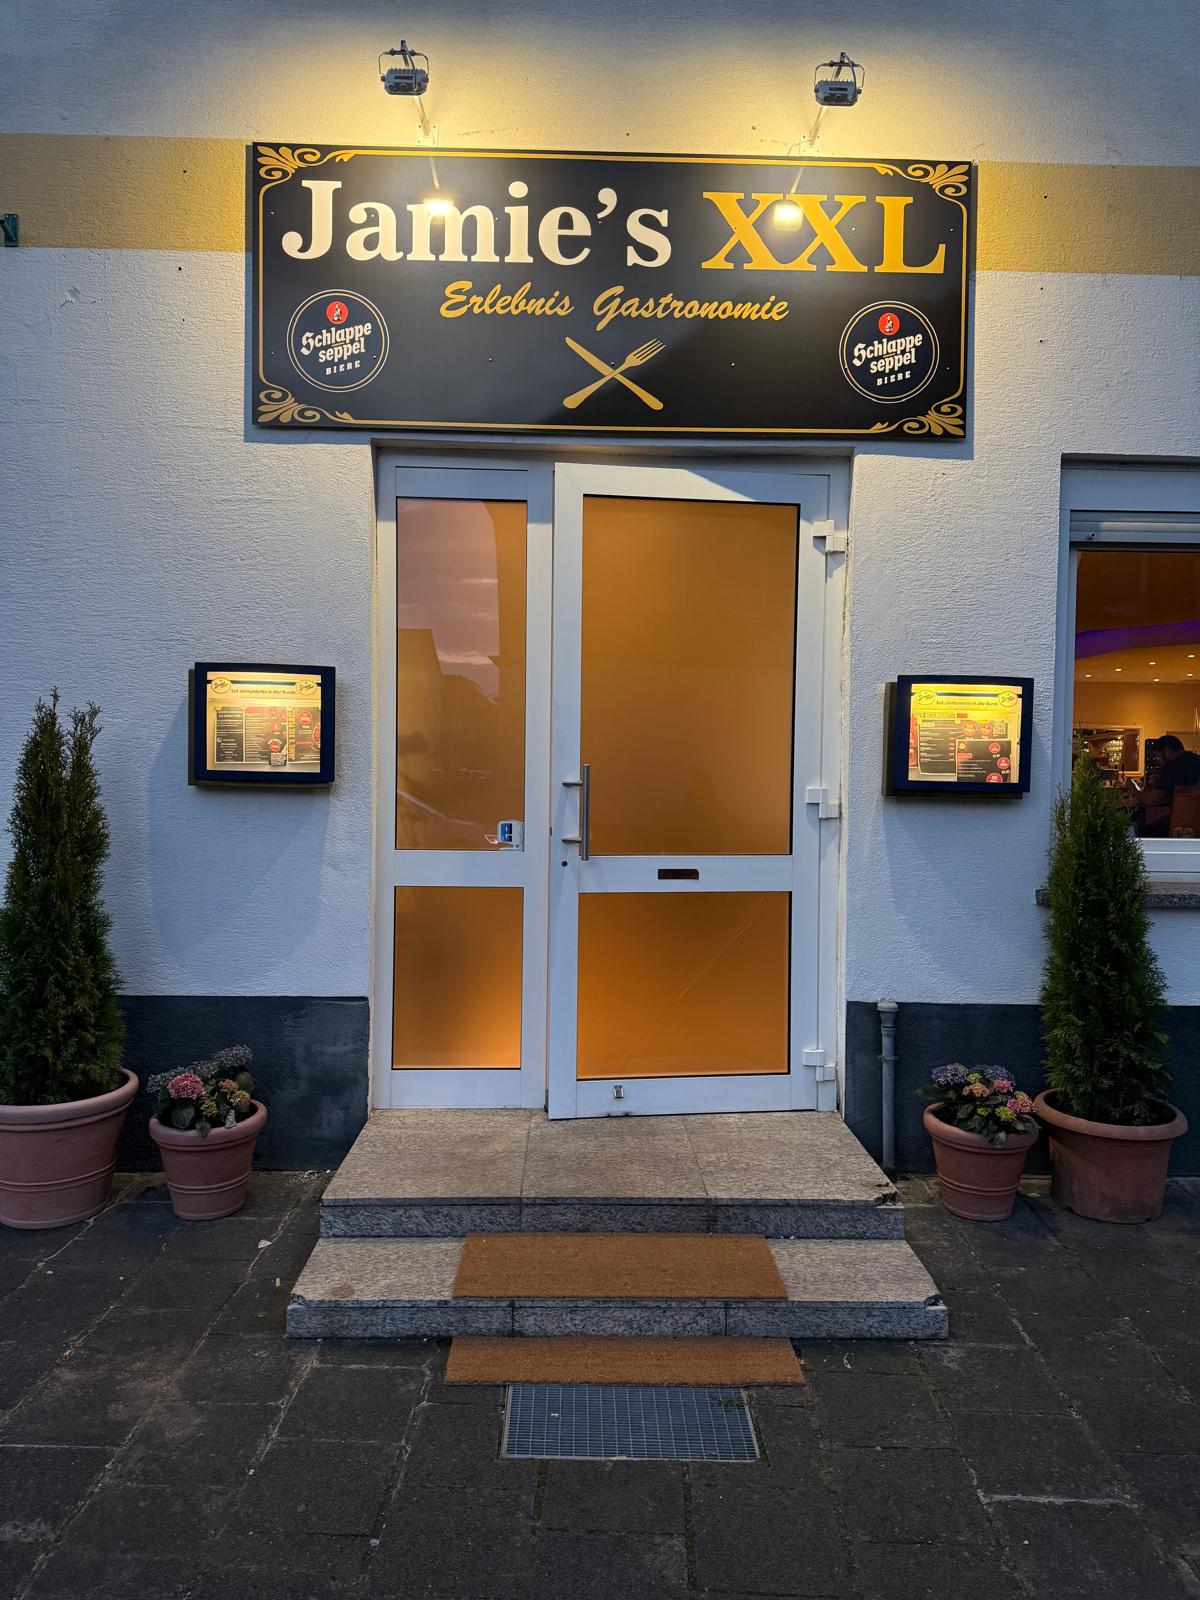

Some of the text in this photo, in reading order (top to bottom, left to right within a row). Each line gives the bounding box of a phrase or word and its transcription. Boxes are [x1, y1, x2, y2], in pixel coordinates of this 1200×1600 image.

[702, 191, 947, 274] XXL
[439, 280, 790, 332] Erlebnis Gastronomie
[301, 323, 372, 356] Schlappe
[318, 337, 366, 363] seppel
[852, 333, 923, 367] Schlappe
[325, 360, 361, 375] BIERE
[869, 347, 917, 374] seppel
[876, 370, 911, 386] BIERE
